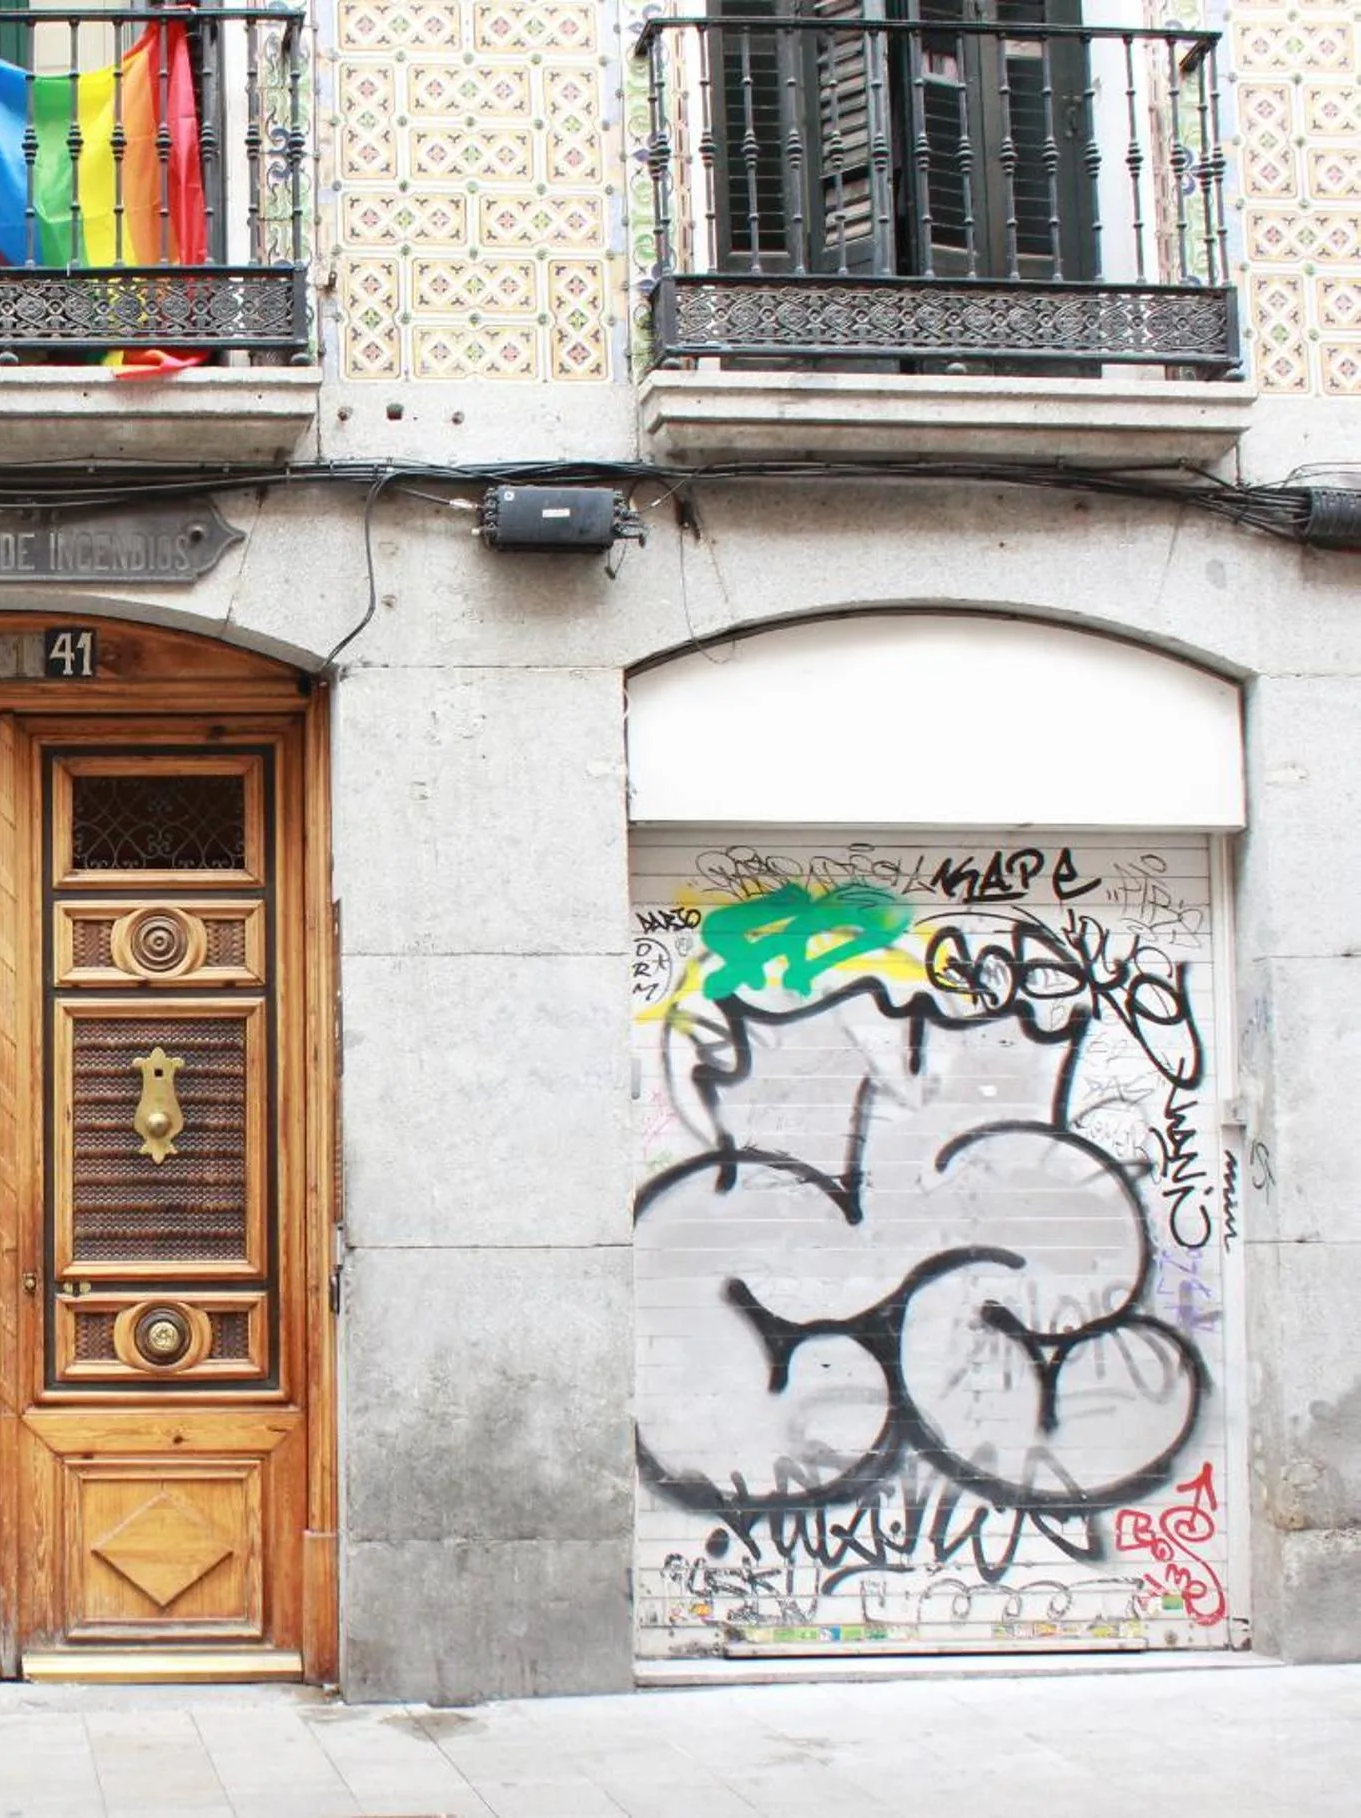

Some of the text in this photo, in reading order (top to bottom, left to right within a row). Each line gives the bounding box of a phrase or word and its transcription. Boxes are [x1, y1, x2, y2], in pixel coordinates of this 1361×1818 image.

[0, 532, 35, 571] DE
[50, 531, 190, 571] INCENDIOS
[49, 632, 92, 676] 41
